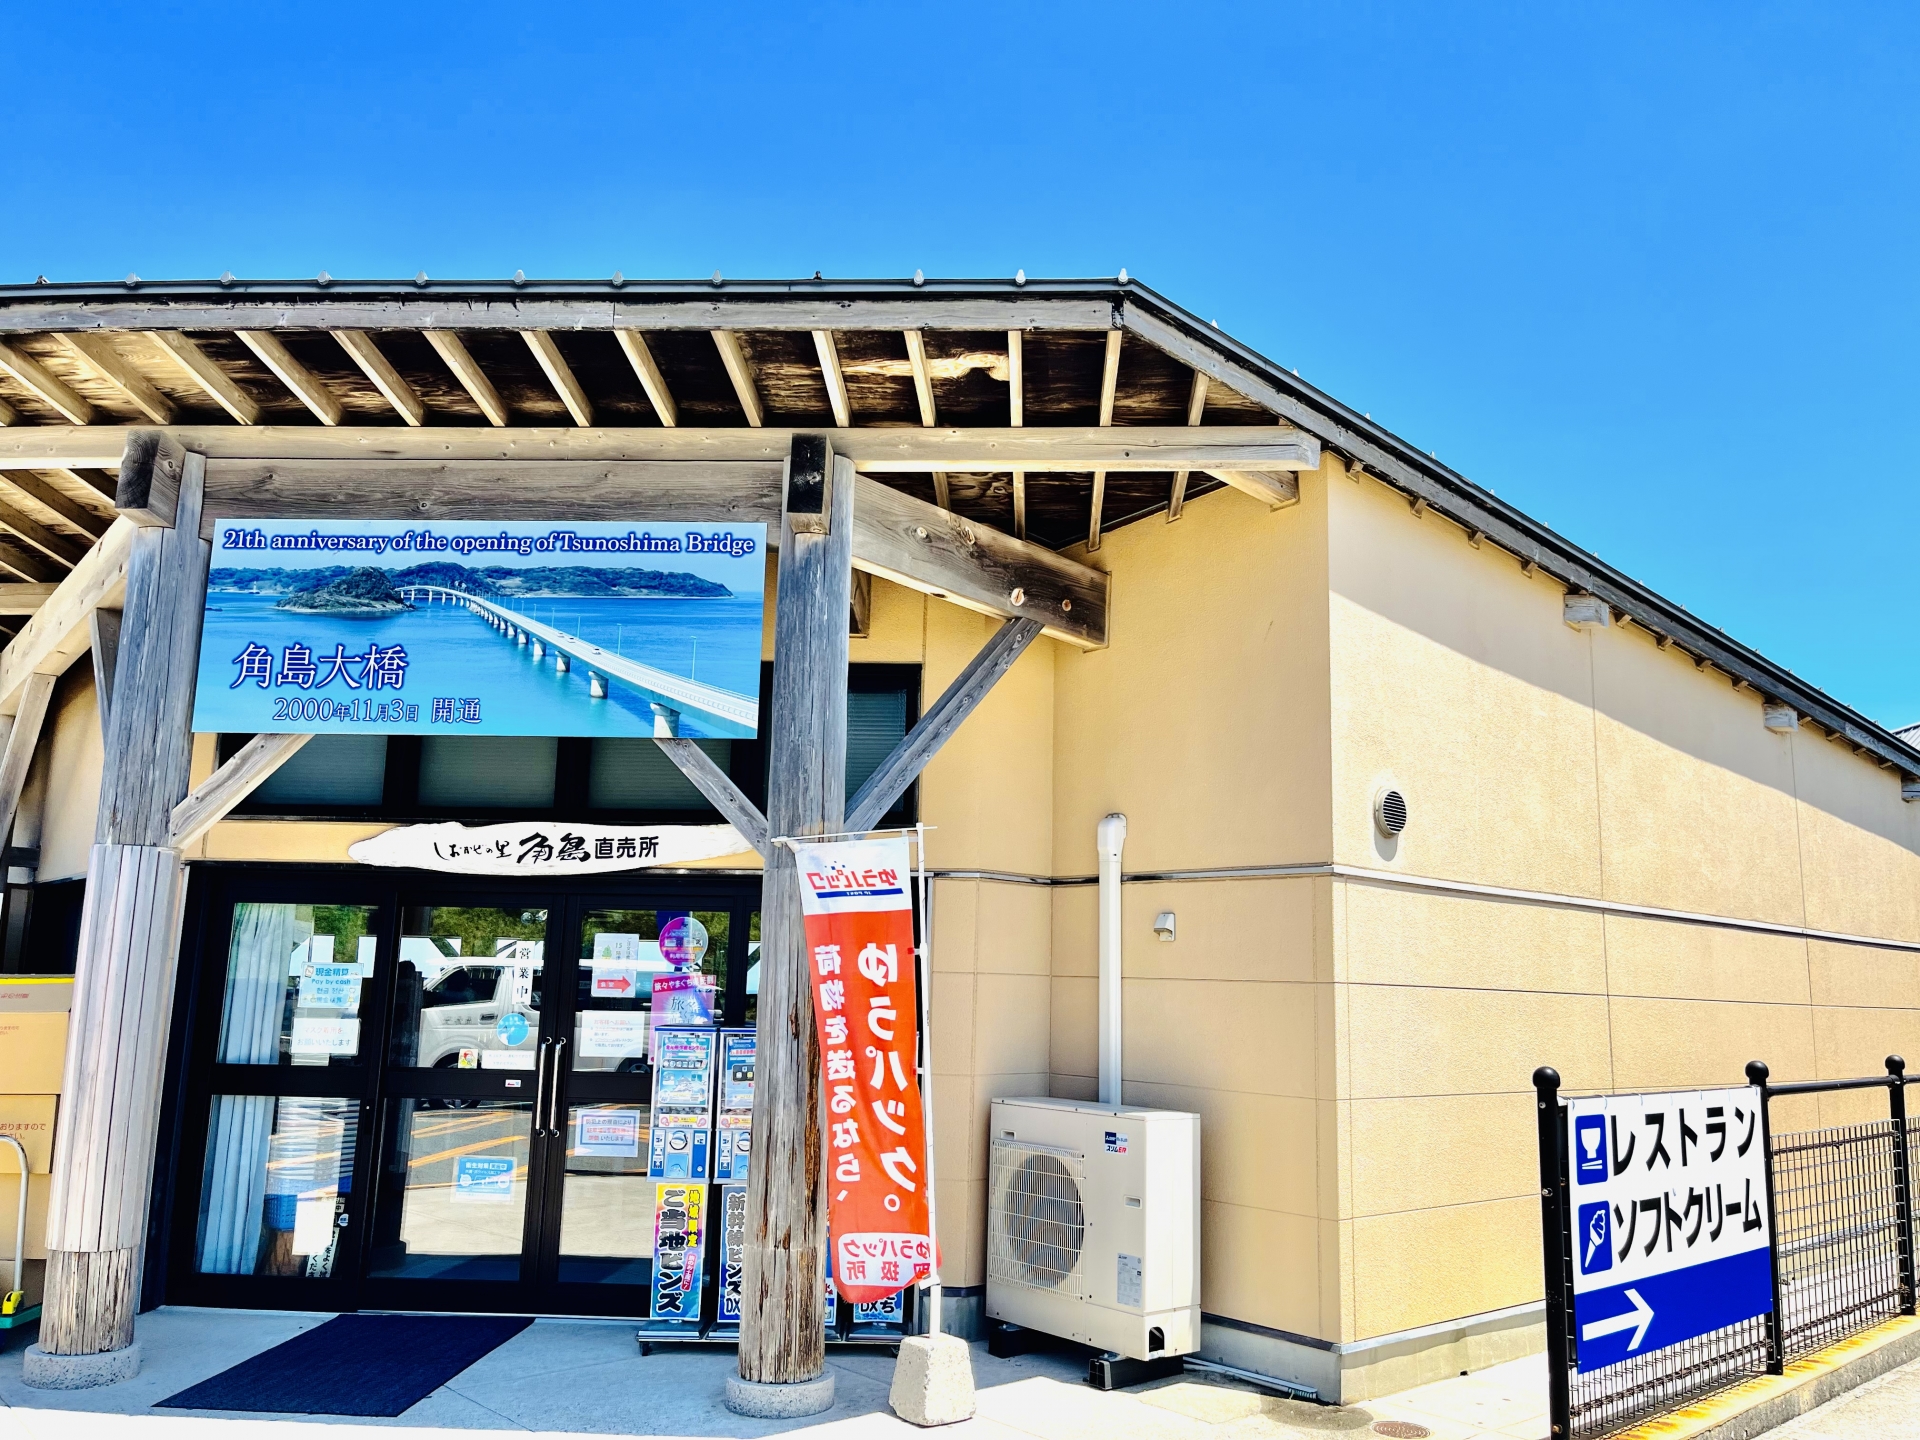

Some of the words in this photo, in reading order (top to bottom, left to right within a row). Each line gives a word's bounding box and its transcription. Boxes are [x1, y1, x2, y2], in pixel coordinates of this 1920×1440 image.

[223, 530, 266, 549] 21th
[271, 531, 389, 553] anniversary
[392, 531, 414, 550] of
[416, 532, 447, 550] the
[451, 532, 532, 554] opening
[536, 533, 557, 551] of
[559, 533, 681, 552] Tsunoshima
[686, 534, 754, 556] Bridge
[230, 643, 408, 690] 角島大橋
[273, 698, 419, 722] 2000年11月3日
[431, 697, 482, 723] 開通
[315, 967, 349, 977] 現金精算
[517, 947, 531, 998] 営業中
[1610, 1105, 1756, 1177] レストラン
[687, 1189, 700, 1248] 地域限定
[1613, 1177, 1763, 1264] ソフトクリーム
[657, 1189, 687, 1313] ご当地ピンズ
[860, 1301, 879, 1312] DX
